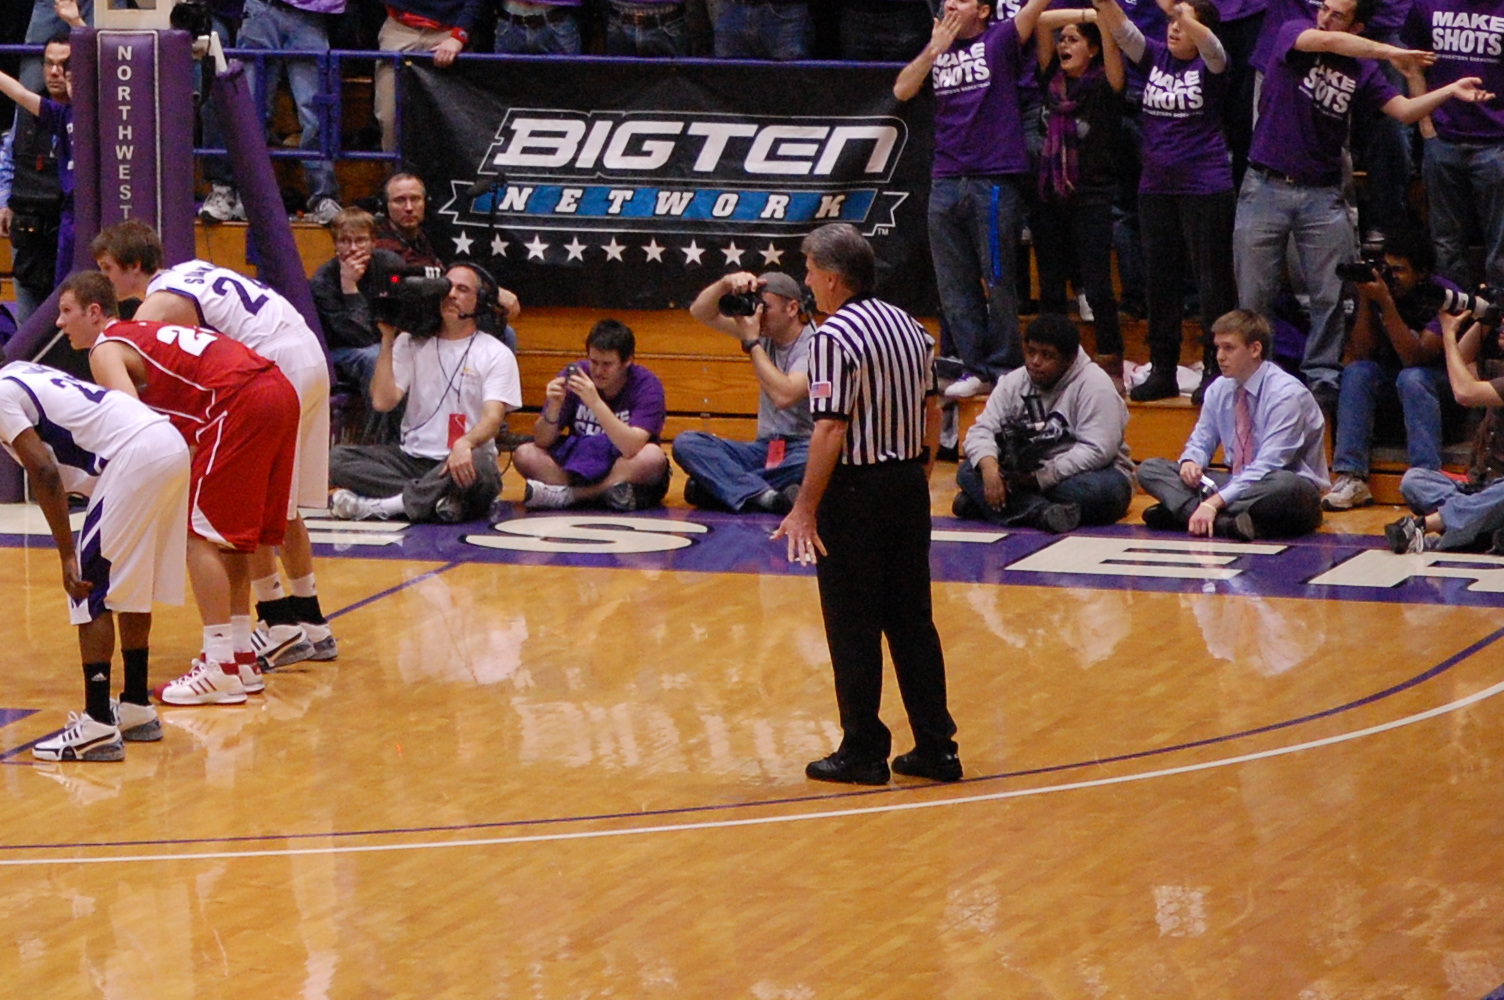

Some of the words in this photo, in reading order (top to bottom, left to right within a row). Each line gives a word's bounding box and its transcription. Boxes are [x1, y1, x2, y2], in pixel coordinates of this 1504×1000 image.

[1432, 11, 1504, 32] MAKE
[937, 42, 985, 66] MAKE
[1432, 27, 1502, 56] SHOTS
[932, 60, 991, 88] SHOTS
[1150, 66, 1200, 92] MAKE
[1142, 86, 1204, 111] SHOTS
[493, 117, 685, 170] BIG
[689, 122, 898, 176] TEN
[498, 186, 846, 220] NETWORK
